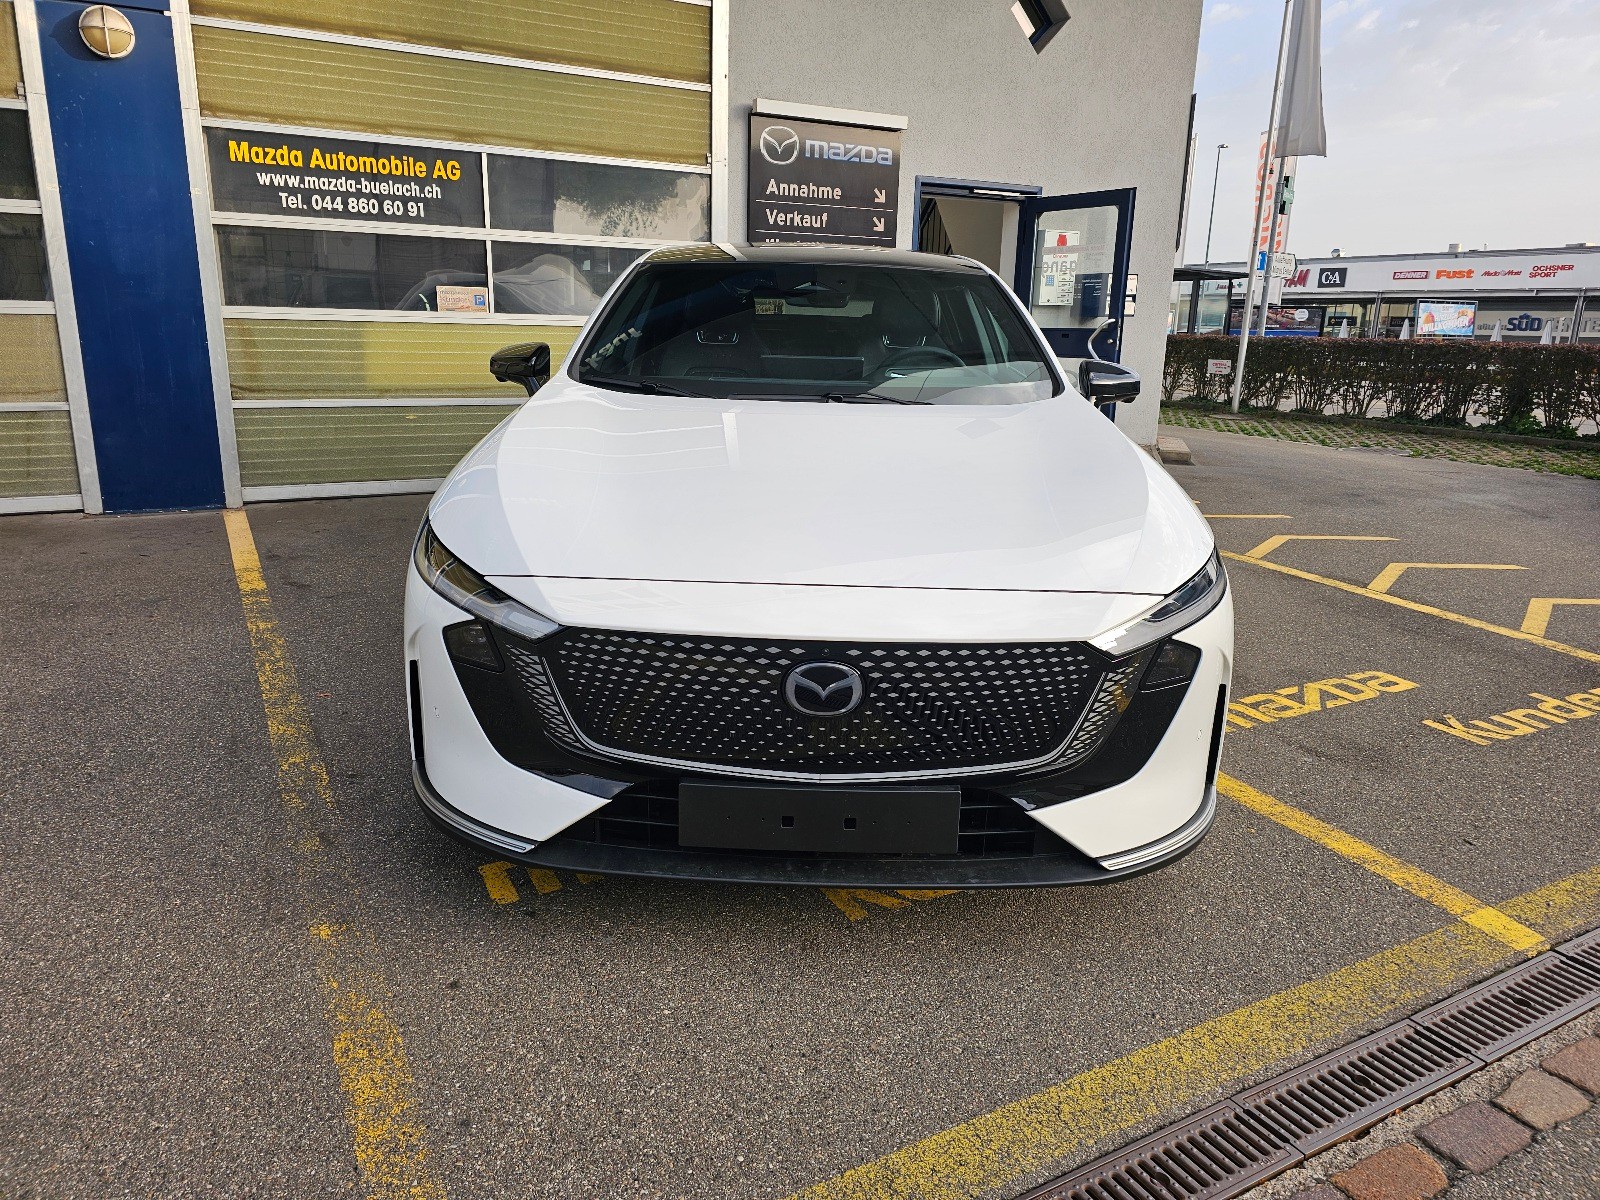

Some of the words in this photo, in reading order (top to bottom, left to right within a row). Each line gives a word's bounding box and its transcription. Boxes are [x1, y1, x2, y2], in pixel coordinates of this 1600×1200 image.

[228, 140, 303, 168] Mazda
[309, 148, 427, 178] Automobile
[432, 159, 461, 181] AG
[805, 139, 893, 166] mazda
[256, 172, 442, 199] www.mazda-buelach.ch
[765, 178, 842, 200] Annahme
[279, 192, 308, 210] Tel.
[311, 195, 344, 212] 044
[348, 197, 379, 214] 860
[383, 200, 404, 216] 60
[407, 202, 425, 218] 91
[765, 208, 828, 228] Verkauf
[1321, 271, 1341, 284] C&A
[1394, 271, 1427, 279] DENNER
[1528, 271, 1558, 279] SPORT
[1532, 264, 1575, 272] OCHSNER
[1422, 687, 1600, 746] Kunde
